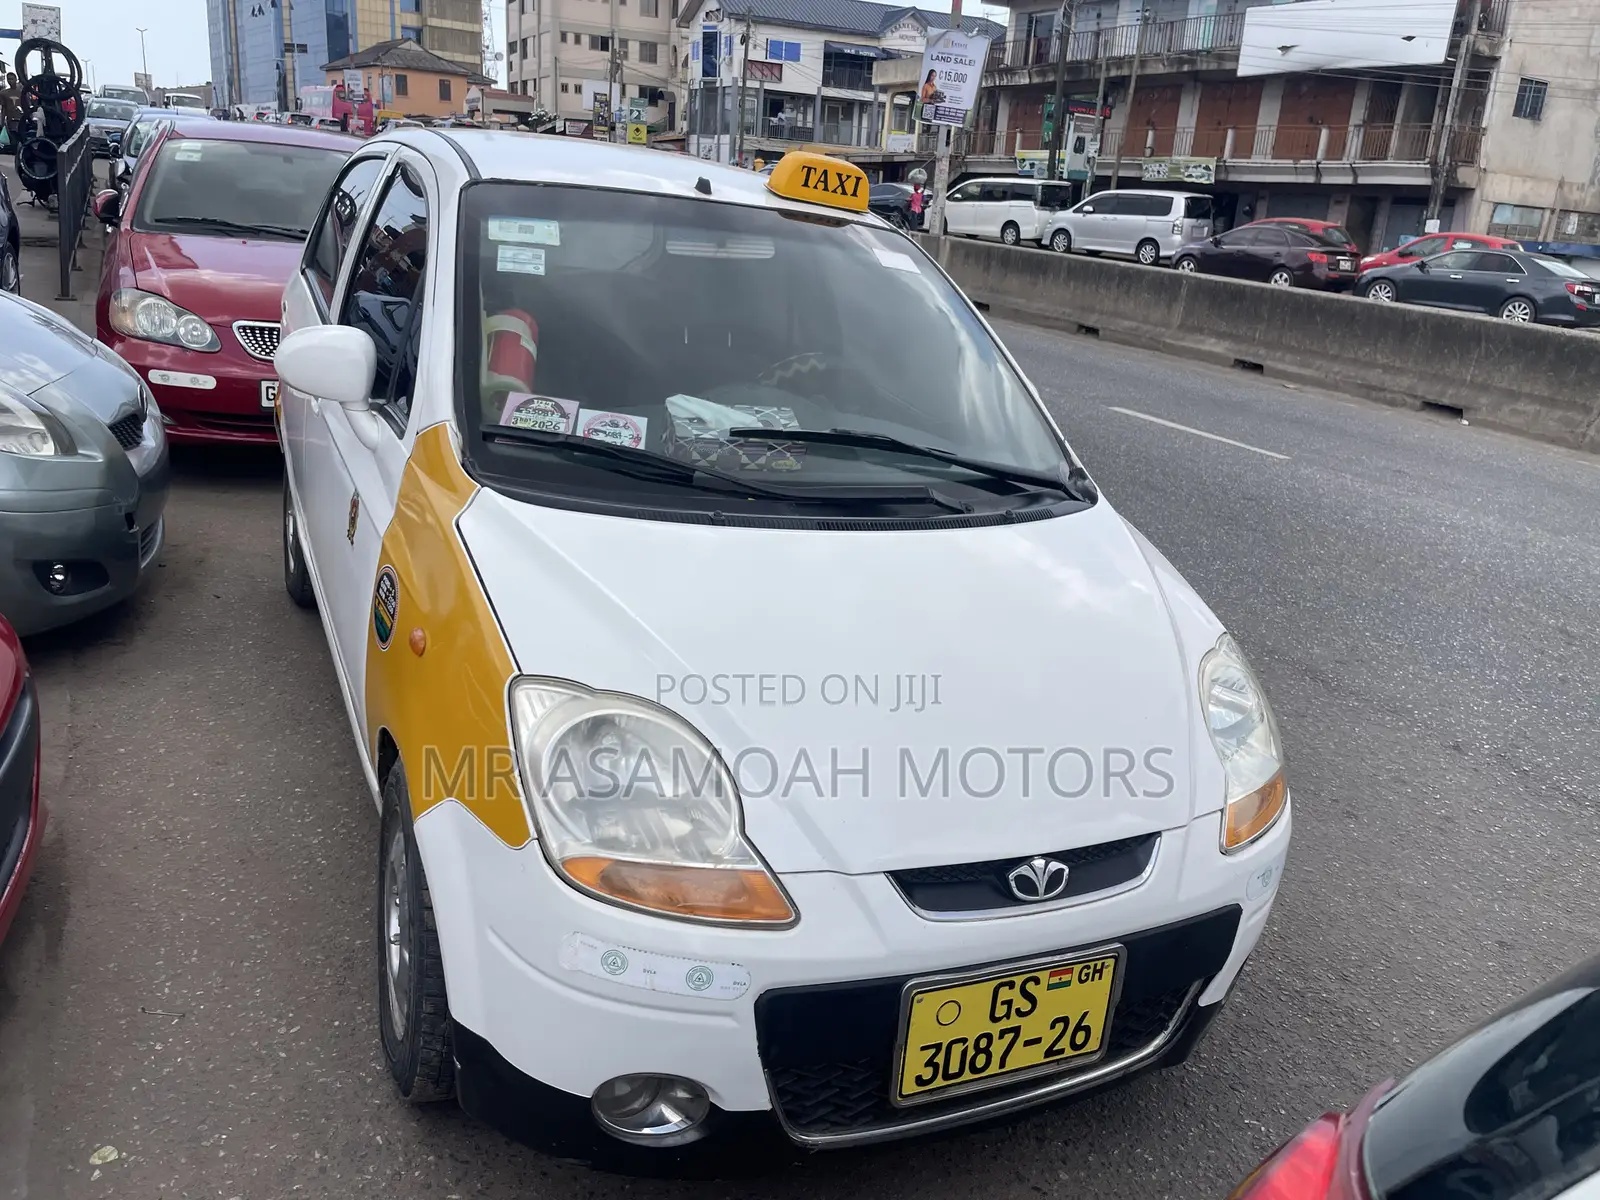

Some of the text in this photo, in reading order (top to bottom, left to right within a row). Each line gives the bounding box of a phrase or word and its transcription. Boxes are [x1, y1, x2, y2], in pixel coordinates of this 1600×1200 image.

[930, 54, 952, 63] LAND
[953, 57, 976, 67] SALE!
[801, 165, 863, 198] TAXI
[531, 420, 561, 431] 2026
[989, 961, 1105, 1024] GS GH
[914, 1010, 1092, 1088] 3087-26
